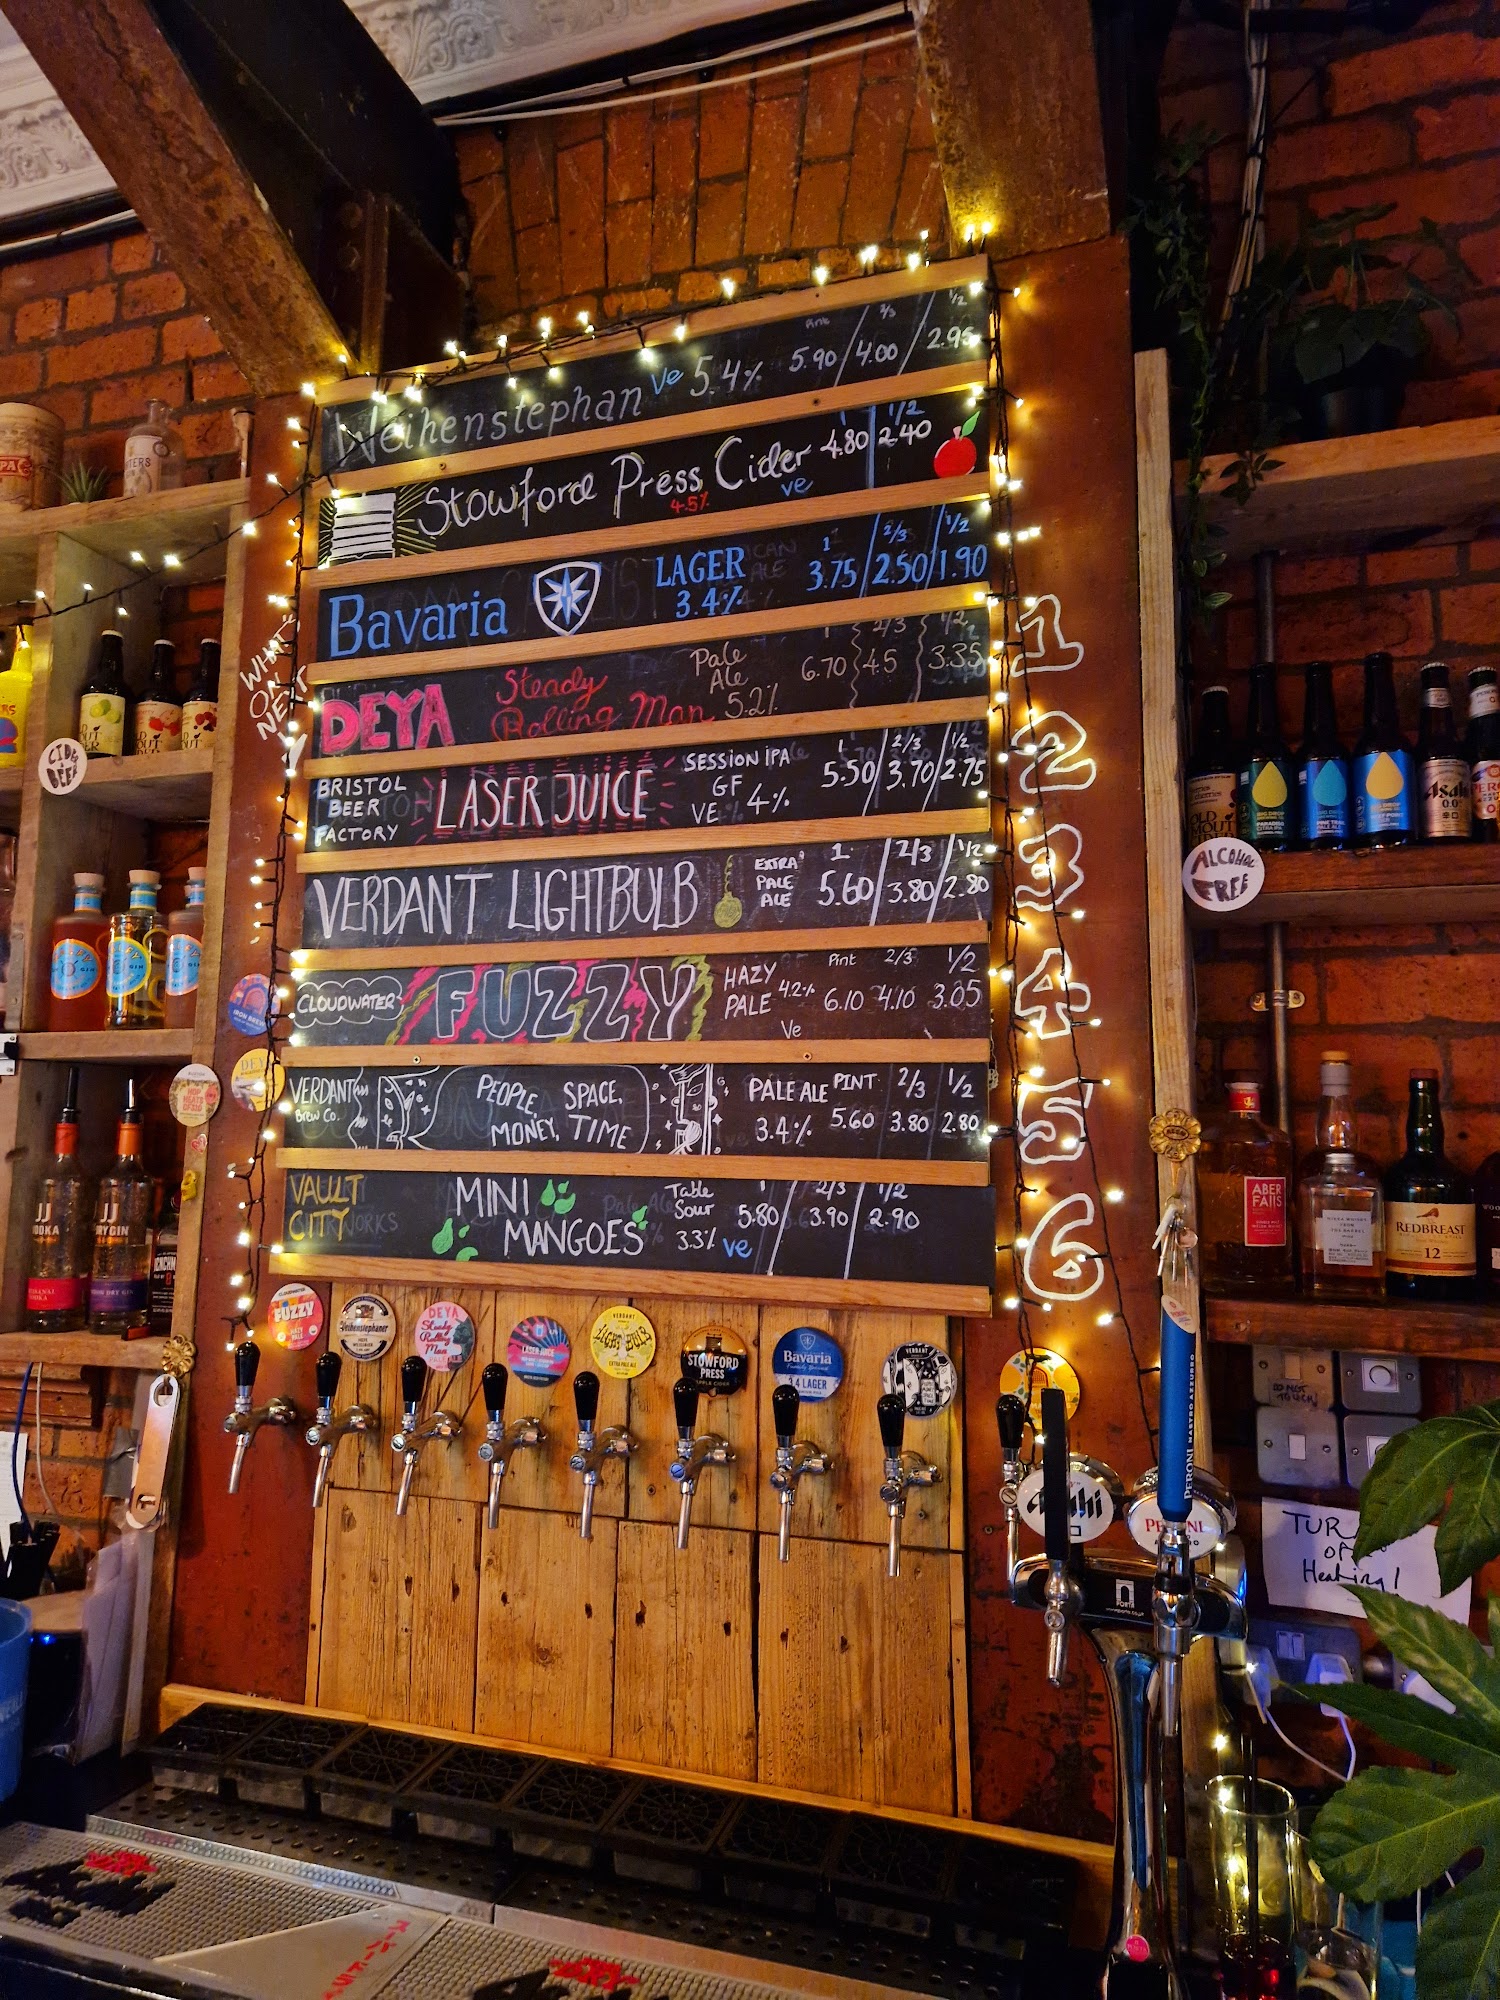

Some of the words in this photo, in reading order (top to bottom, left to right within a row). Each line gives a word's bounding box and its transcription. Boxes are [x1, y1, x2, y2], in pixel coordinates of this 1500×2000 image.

[335, 386, 642, 465] Weihenstephan
[789, 349, 837, 371] 5.90
[856, 341, 898, 365] 4.00
[888, 401, 925, 427] 1/2
[418, 467, 598, 536] Stowford
[611, 452, 703, 519] Press
[715, 435, 812, 490] Cider
[820, 430, 869, 459] 4.80
[879, 420, 932, 445] 2.40
[328, 590, 509, 657] Bavaria
[656, 546, 746, 587] LAGER
[806, 559, 857, 591] 3.75
[872, 550, 929, 583] 2.50
[939, 544, 987, 580] 1.90
[676, 586, 745, 619] 3.4%
[1010, 594, 1084, 677] 1
[690, 641, 747, 676] Pale
[802, 656, 847, 681] 6.70
[496, 666, 608, 709] Steady
[710, 669, 748, 694] Ale
[320, 684, 455, 754] DEYA
[1011, 711, 1096, 793] 2
[317, 776, 407, 798] BRISTOL
[435, 777, 545, 830] LASER
[555, 770, 654, 823] JUICE
[684, 749, 759, 772] SESSION
[328, 799, 380, 818] BEER
[821, 761, 875, 788] 5.50
[887, 760, 934, 791] 3.70
[941, 759, 986, 787] 2.75
[712, 775, 742, 796] GF
[692, 802, 719, 824] VE
[747, 783, 790, 815] 4%
[313, 824, 399, 847] FACTORY
[1014, 824, 1084, 911] 3
[1190, 847, 1255, 875] ALCOHOL
[313, 873, 493, 938] VERDANT
[508, 862, 698, 934] LIGHTBULB
[754, 856, 798, 870] EXTRA
[757, 875, 794, 890] PALE
[819, 869, 874, 907] 5.60
[887, 879, 935, 903] 3.80
[942, 875, 990, 900] 2.80
[761, 893, 792, 908] ALE
[1191, 873, 1249, 902] FREE
[828, 953, 856, 967] Pint
[884, 949, 913, 965] 2/3
[947, 944, 976, 974] 1/2
[297, 992, 395, 1013] CLOUDWATER
[435, 963, 696, 1042] FUZZY
[724, 962, 776, 991] HAZY
[823, 987, 865, 1011] 6.10
[878, 984, 916, 1011] 4.10
[932, 980, 981, 1010] 3.05
[724, 992, 771, 1020] PALE
[1015, 948, 1091, 1040] 4
[781, 1020, 801, 1039] Ve
[290, 1077, 353, 1104] VERDANT
[749, 1079, 799, 1102] PALE
[800, 1083, 828, 1102] ALE
[833, 1072, 878, 1091] PINT
[897, 1067, 926, 1098] 2/3
[948, 1067, 974, 1098] 1/2
[491, 1118, 560, 1147] MONEY,
[568, 1114, 632, 1150] TIME
[756, 1115, 812, 1145] 3.4%
[830, 1107, 875, 1130] 5.60
[889, 1113, 930, 1133] 3.80
[941, 1112, 979, 1133] 2.80
[1018, 1077, 1093, 1164] 5
[290, 1174, 364, 1206] VAULT
[456, 1176, 529, 1217] MINI
[665, 1180, 714, 1199] Table
[1252, 1183, 1282, 1195] ABER
[35, 1203, 51, 1222] JJ
[100, 1203, 119, 1222] JJ
[289, 1207, 349, 1242] CITY
[503, 1219, 645, 1257] MANGOES
[674, 1199, 713, 1220] Sour
[737, 1203, 780, 1229] 5.80
[809, 1206, 849, 1229] 3.90
[869, 1207, 921, 1230] 2.90
[1396, 1222, 1466, 1234] REDBREAST
[1024, 1193, 1104, 1300] 6
[1424, 1247, 1440, 1259] 12
[274, 1301, 314, 1323] FUZZY
[428, 1307, 459, 1319] DEYA
[687, 1354, 740, 1369] STOWFORD
[700, 1369, 726, 1379] PRESS
[783, 1350, 832, 1364] Bavaria
[802, 1378, 827, 1390] LAGER
[1184, 1448, 1194, 1500] PERONI
[1282, 1510, 1359, 1540] TUR
